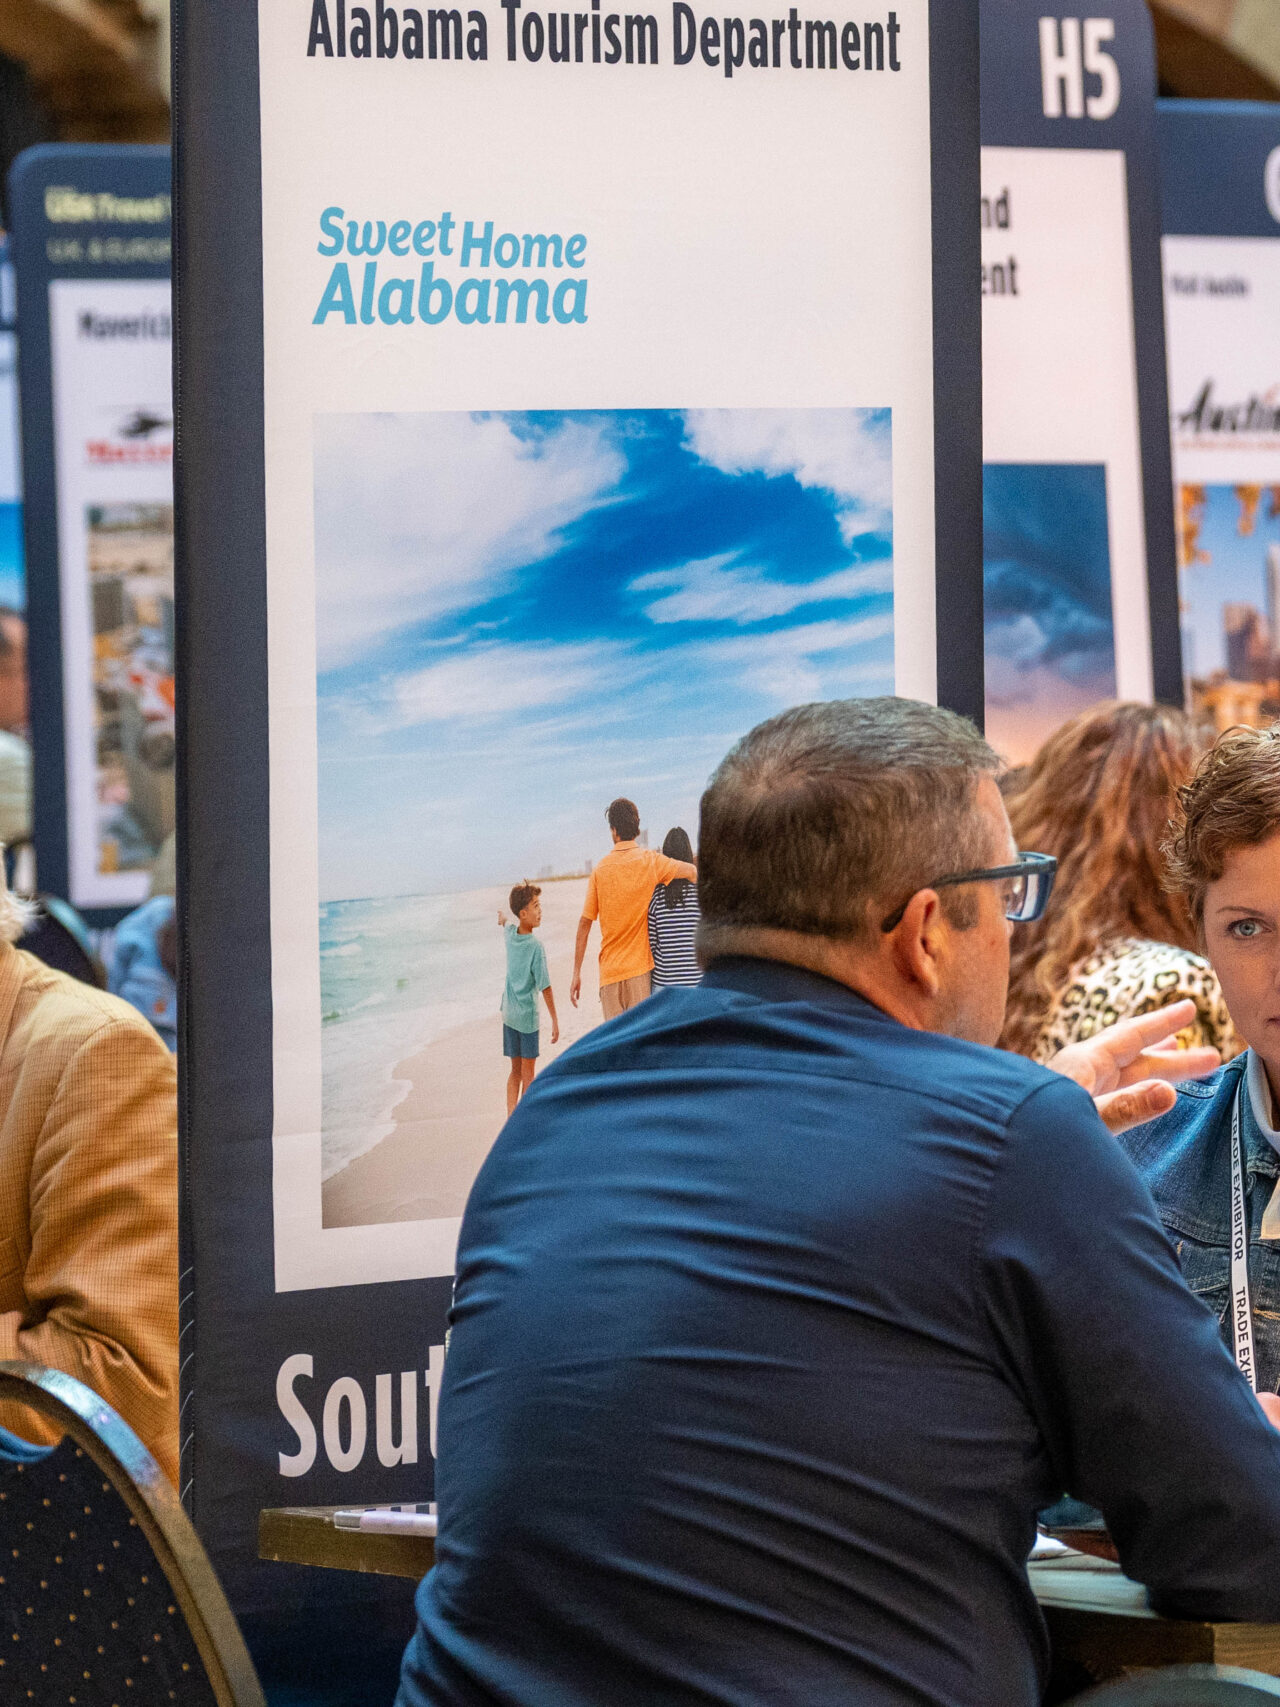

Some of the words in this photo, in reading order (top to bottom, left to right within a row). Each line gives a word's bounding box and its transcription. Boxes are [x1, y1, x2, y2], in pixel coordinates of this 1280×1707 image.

[307, 0, 488, 61] Alabama
[500, 0, 659, 65] Tourism
[672, 1, 900, 78] Department
[1038, 17, 1121, 120] H5
[317, 206, 455, 257] Sweet
[459, 221, 588, 269] Home
[311, 261, 589, 326] Alabama
[1231, 1115, 1241, 1171] TRADE
[1232, 1174, 1244, 1262] EXHIBITOR
[1234, 1286, 1250, 1341] TRADE
